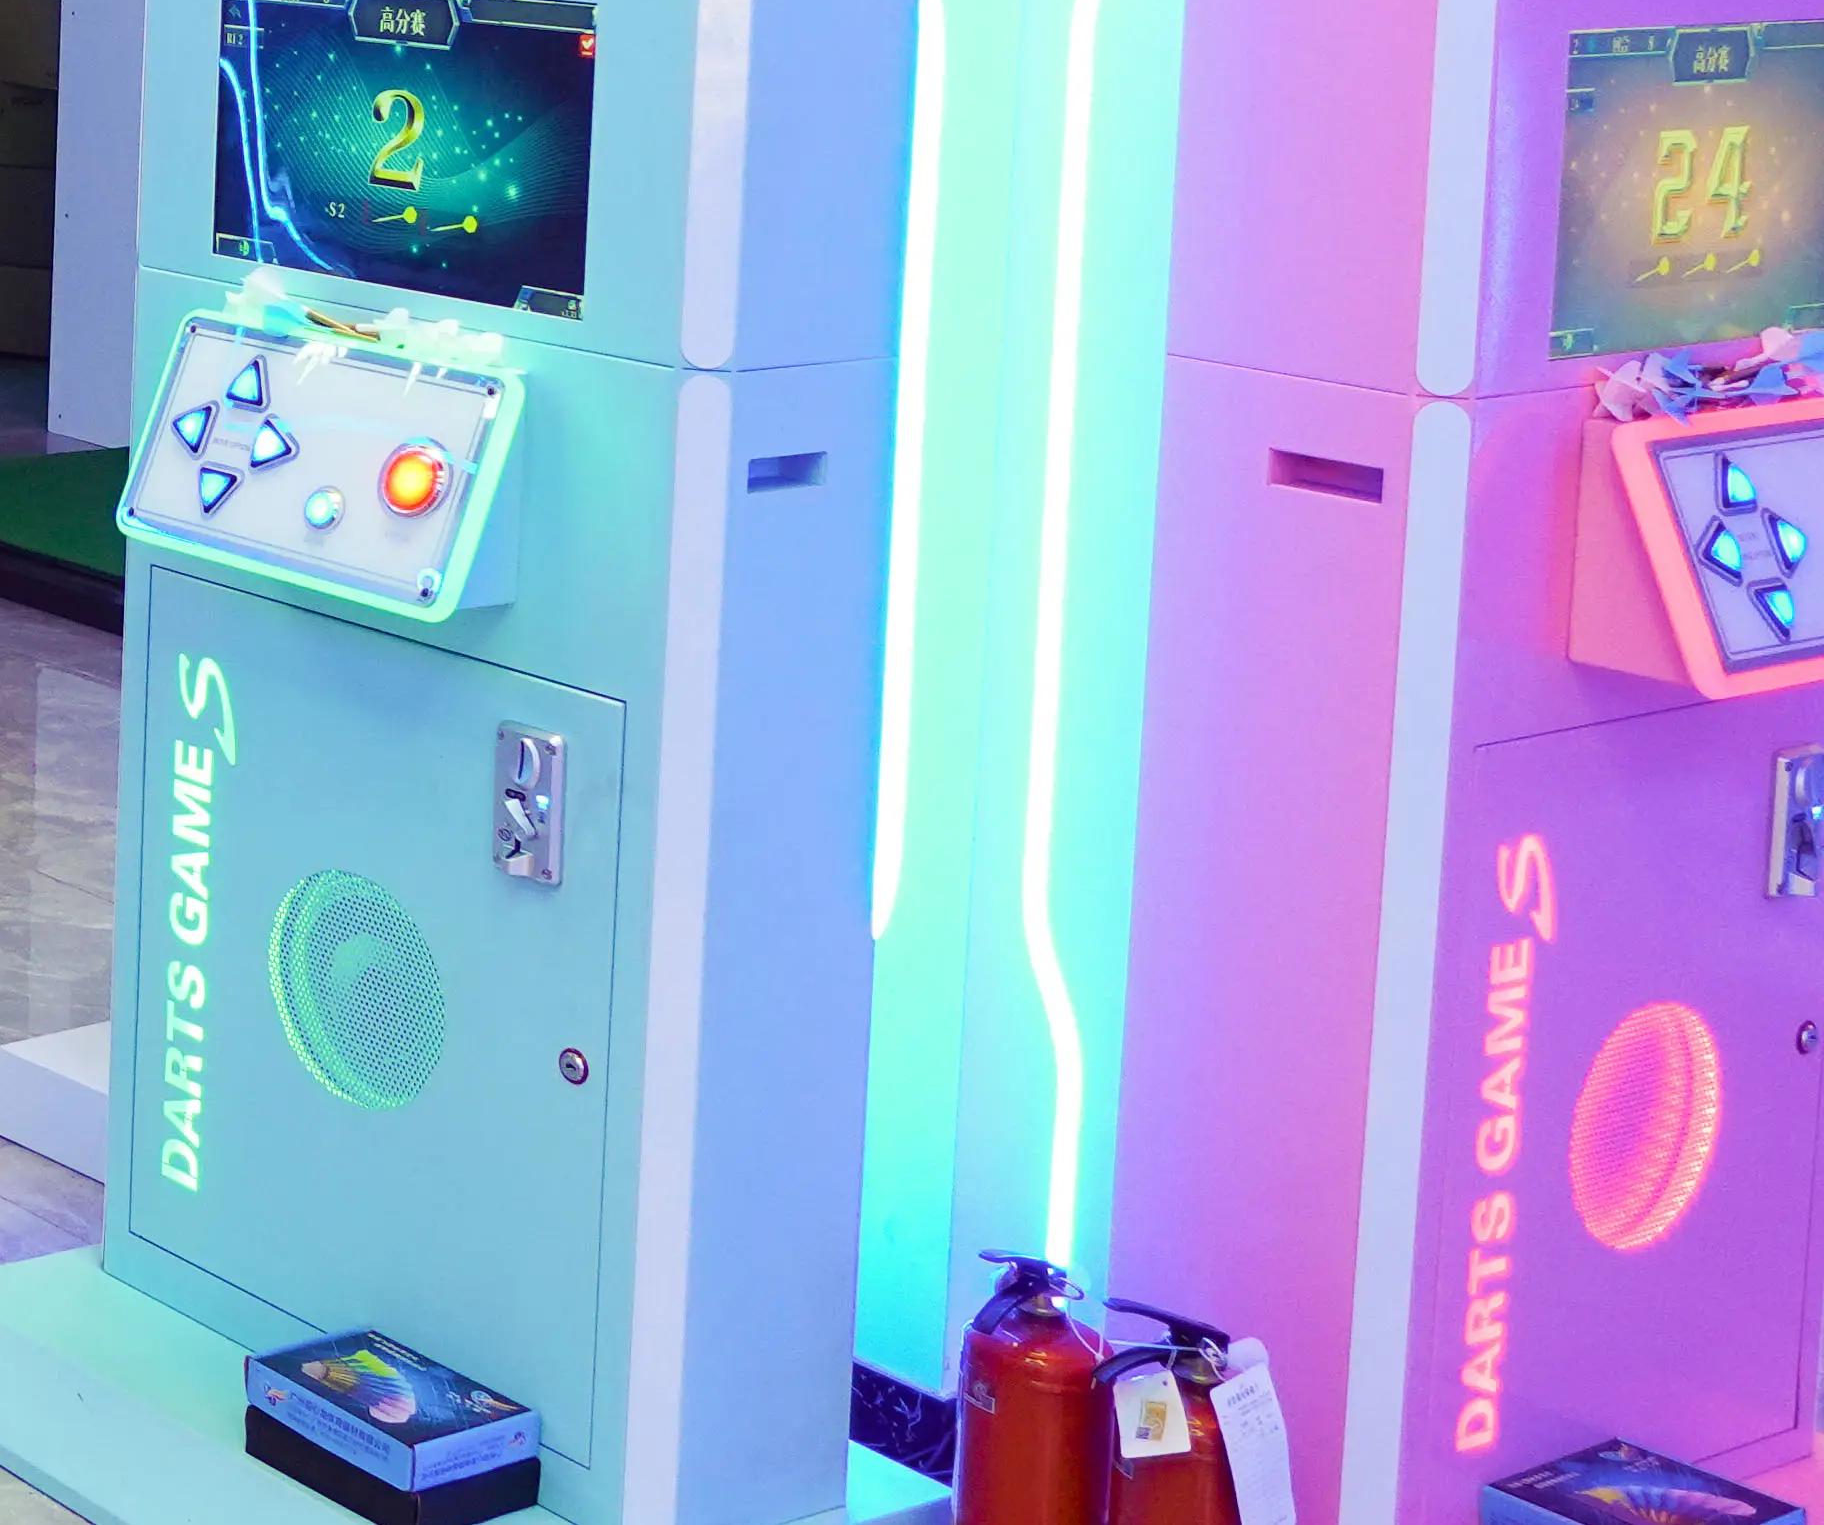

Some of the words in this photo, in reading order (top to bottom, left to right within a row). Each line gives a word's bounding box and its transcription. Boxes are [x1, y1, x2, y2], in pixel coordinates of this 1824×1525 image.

[380, 6, 426, 37] 高分赛
[368, 89, 425, 192] 2
[1652, 125, 1752, 246] 24
[159, 959, 207, 1193] DARTS
[1453, 1188, 1514, 1455] DARTS
